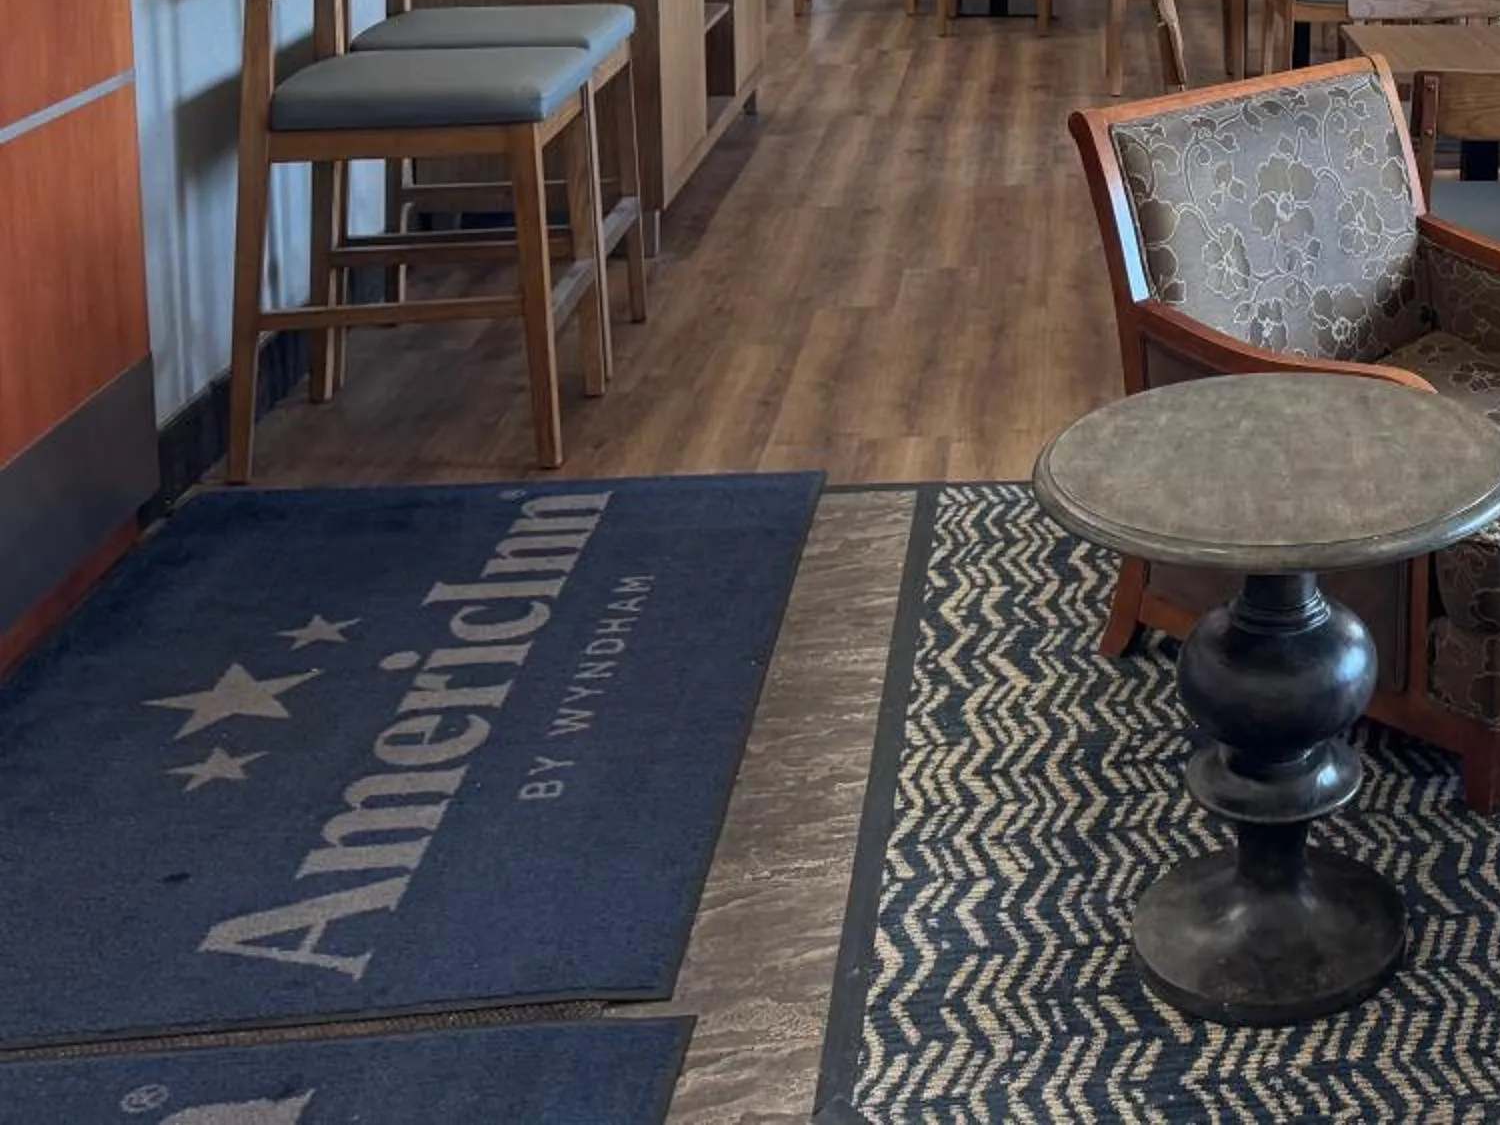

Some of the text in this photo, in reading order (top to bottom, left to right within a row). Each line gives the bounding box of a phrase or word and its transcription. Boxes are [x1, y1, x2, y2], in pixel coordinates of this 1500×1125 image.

[199, 489, 614, 981] AmericInn
[518, 573, 656, 801] BY WYNDHAM
